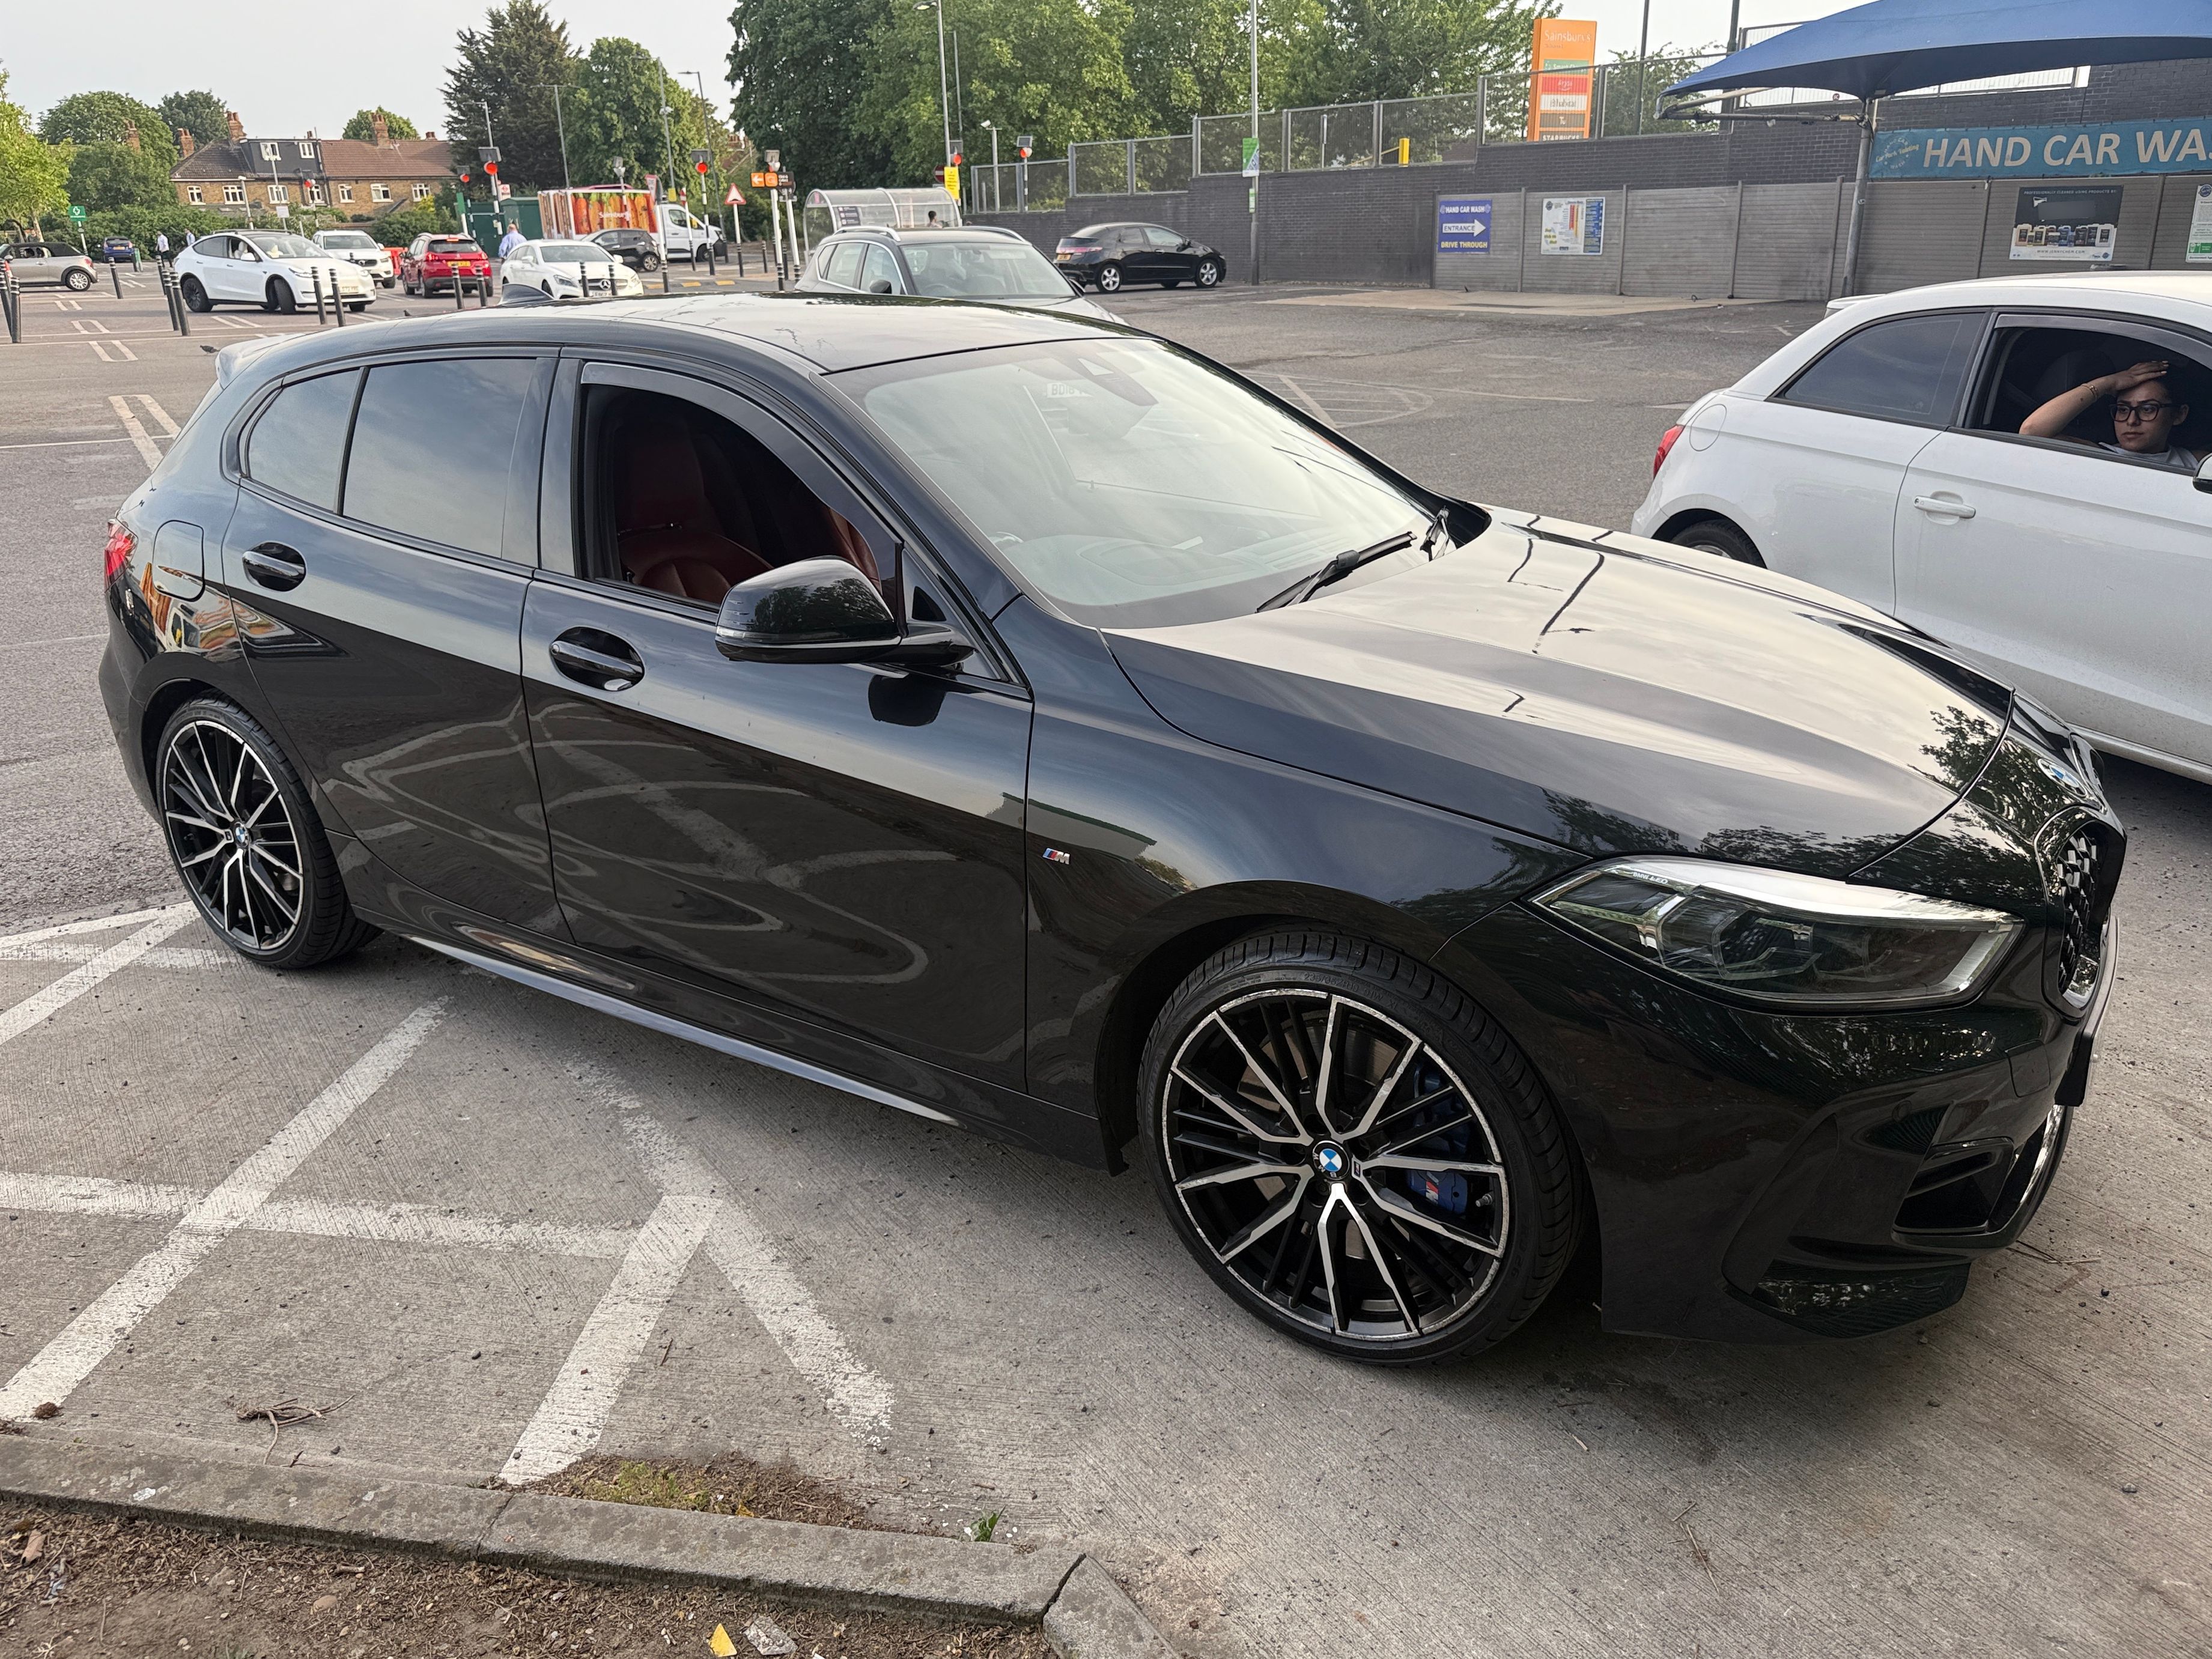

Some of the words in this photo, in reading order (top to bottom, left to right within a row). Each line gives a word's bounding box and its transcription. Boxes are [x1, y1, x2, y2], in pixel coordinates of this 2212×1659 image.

[1544, 30, 1591, 44] Sainsbury's
[1923, 136, 2031, 168] HAND
[2043, 133, 2121, 166] CAR
[2136, 129, 2212, 163] WA
[1633, 872, 1649, 880] BMW
